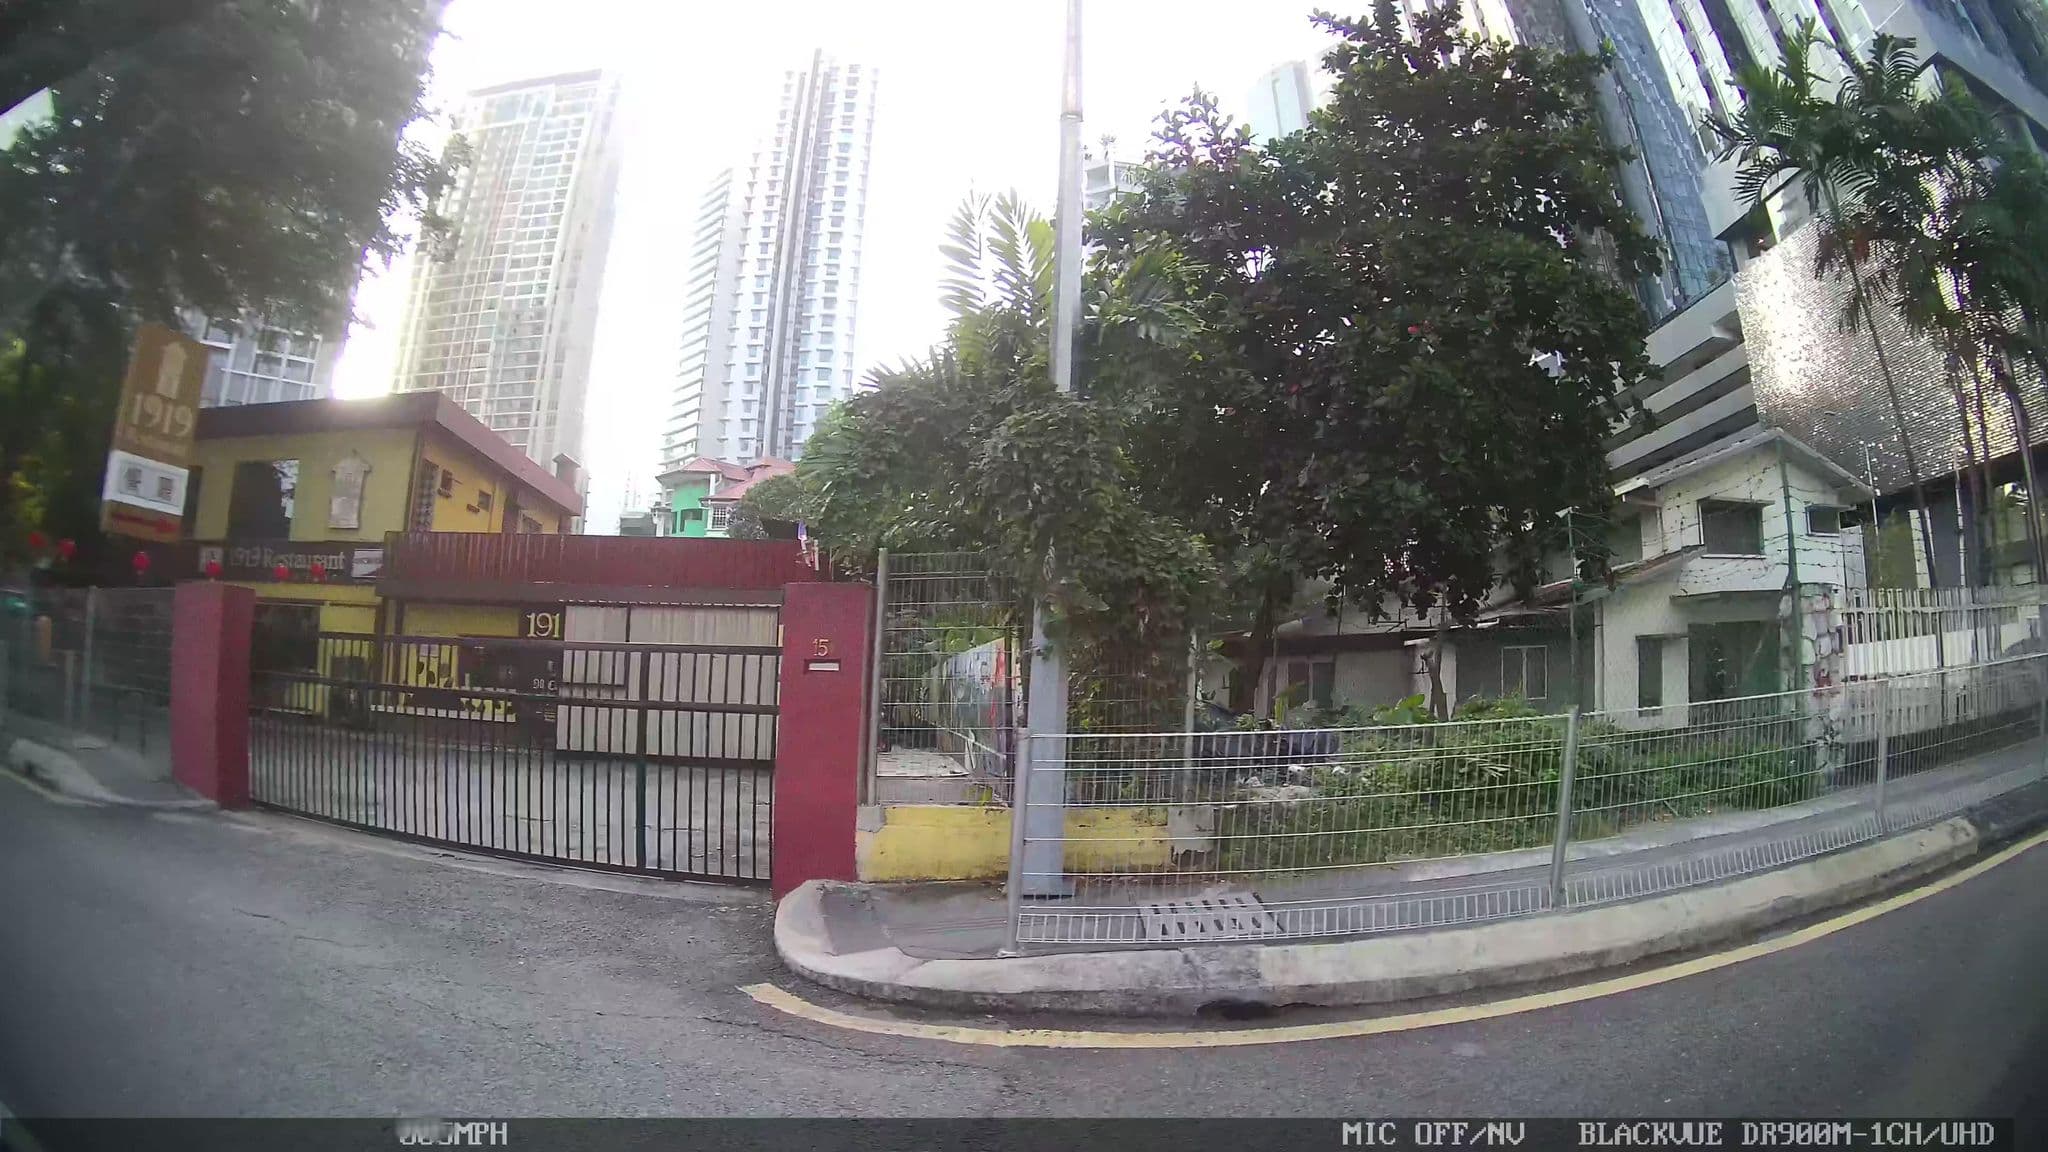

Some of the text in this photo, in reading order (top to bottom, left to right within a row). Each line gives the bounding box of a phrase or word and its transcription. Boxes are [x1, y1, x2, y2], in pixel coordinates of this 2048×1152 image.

[130, 392, 193, 437] 1919
[263, 546, 346, 570] Restaurant
[812, 638, 829, 657] 15
